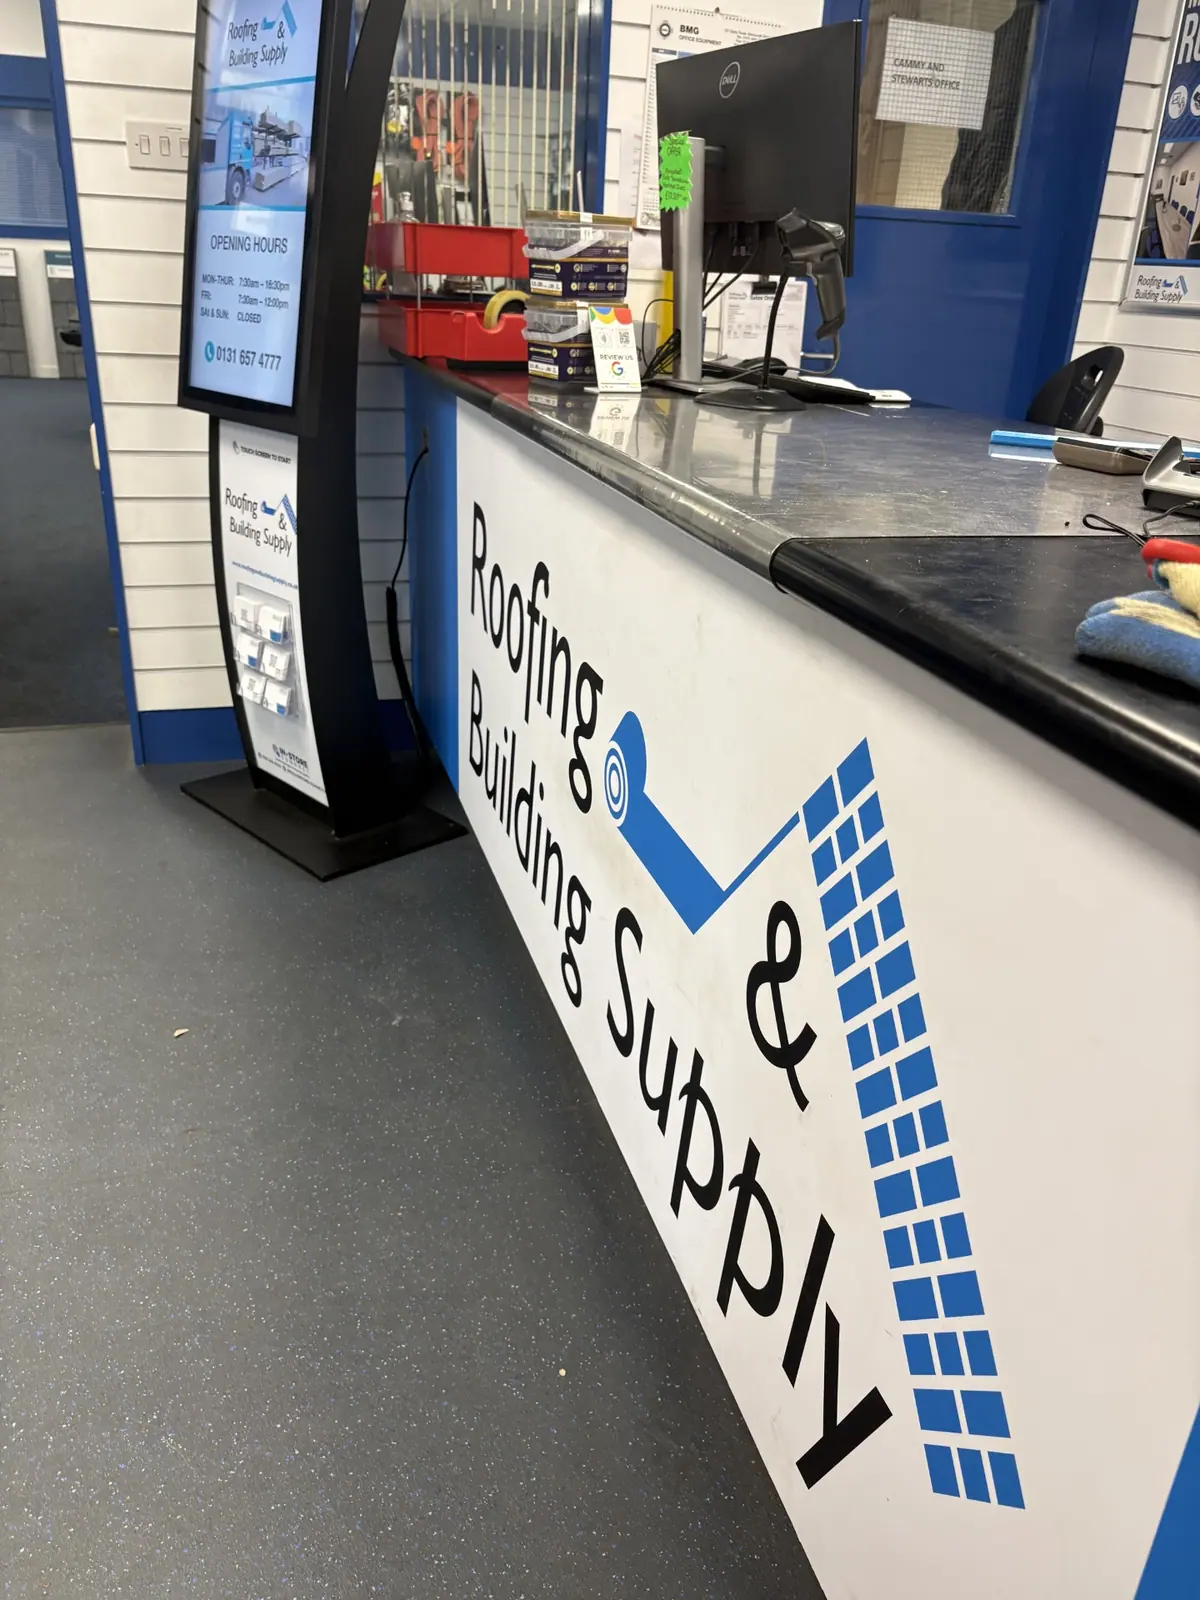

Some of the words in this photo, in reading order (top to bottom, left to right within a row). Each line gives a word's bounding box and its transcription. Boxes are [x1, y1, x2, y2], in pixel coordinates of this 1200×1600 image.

[228, 18, 259, 42] Roofing
[277, 21, 285, 39] &
[679, 24, 699, 35] BMG
[229, 48, 259, 68] Building
[260, 41, 288, 67] Supply
[893, 58, 925, 71] CAMMY
[926, 61, 945, 72] AND
[721, 74, 737, 85] DELL
[891, 74, 933, 88] STEWARTS
[934, 79, 961, 90] OFFICE
[210, 235, 251, 252] OPENING
[253, 236, 288, 254] HOURS
[1136, 274, 1162, 290] Roofing
[1134, 288, 1160, 303] Building
[1160, 290, 1183, 304] Supply
[237, 311, 261, 324] CLOSED
[216, 346, 237, 362] 0131
[239, 349, 256, 367] 657
[258, 352, 282, 371] 4777
[240, 446, 254, 455] TOUCH
[254, 449, 271, 460] SCREEN
[277, 455, 291, 464] START
[225, 487, 258, 520] Roofing
[278, 512, 287, 531] &
[229, 516, 261, 547] Building
[263, 527, 293, 557] Supply
[471, 500, 604, 814] Roofing
[747, 900, 818, 1112] &
[469, 668, 592, 1008] Building
[606, 906, 894, 1490] Supply
